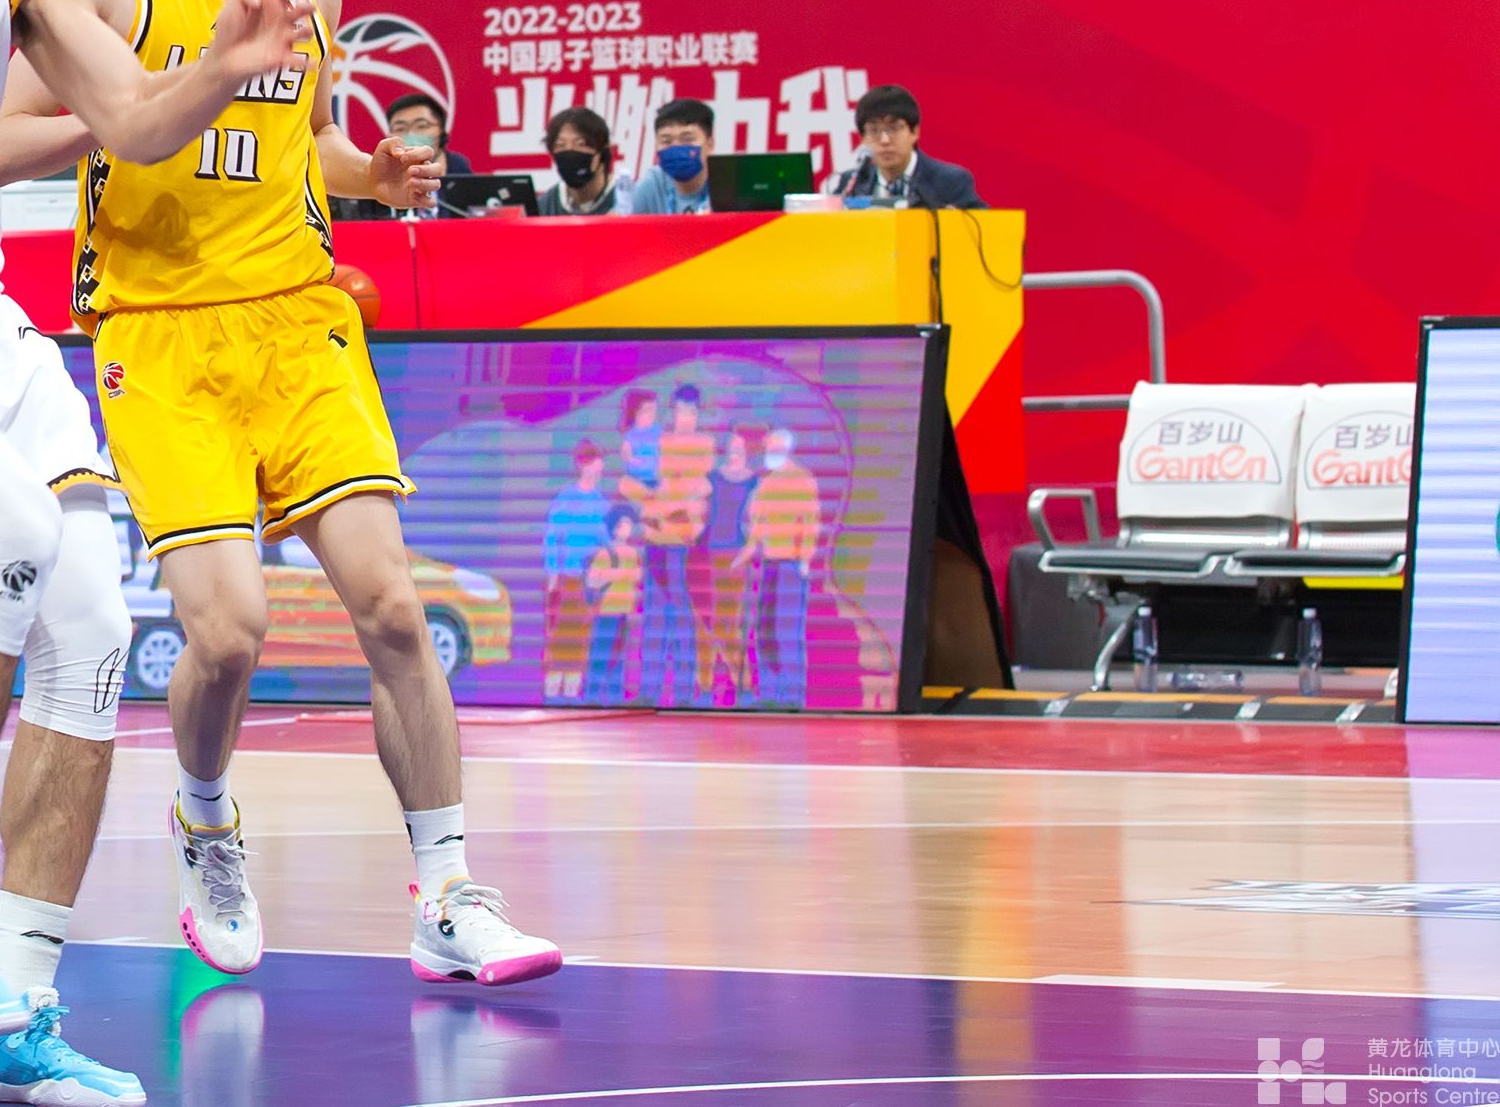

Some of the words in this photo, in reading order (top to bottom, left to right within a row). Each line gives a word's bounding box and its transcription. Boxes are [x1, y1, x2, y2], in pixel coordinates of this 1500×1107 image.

[483, 2, 642, 36] 2022-2023
[483, 32, 758, 76] 中国男子篮球职业联赛
[194, 127, 263, 183] 10
[1157, 421, 1244, 445] 百岁山
